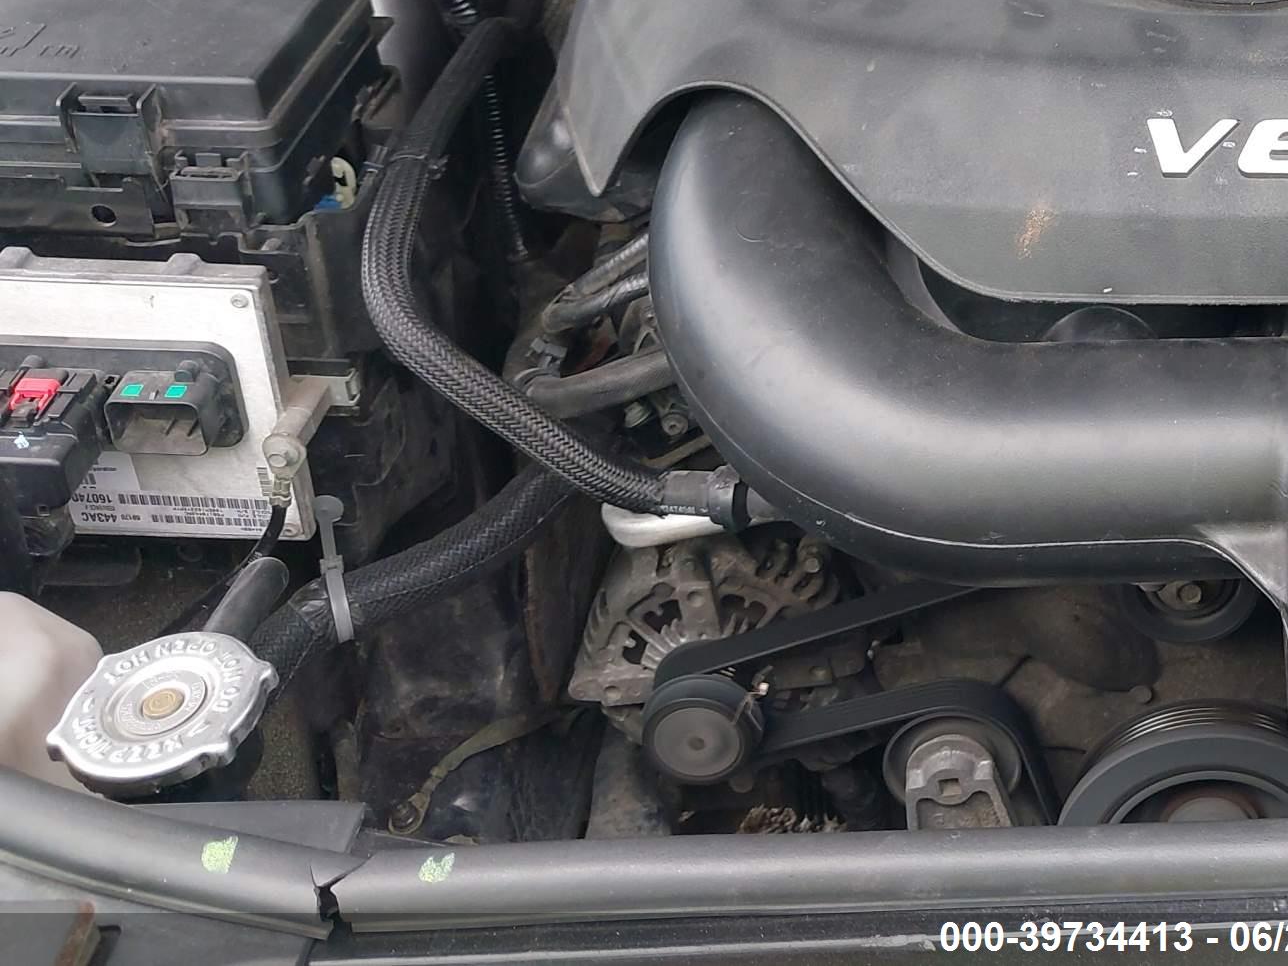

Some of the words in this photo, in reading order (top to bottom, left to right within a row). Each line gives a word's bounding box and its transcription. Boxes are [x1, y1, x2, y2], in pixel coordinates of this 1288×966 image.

[80, 512, 118, 523] 443AC
[154, 638, 218, 659] OPEN
[104, 649, 150, 684] HOT
[110, 734, 183, 763] KEEP
